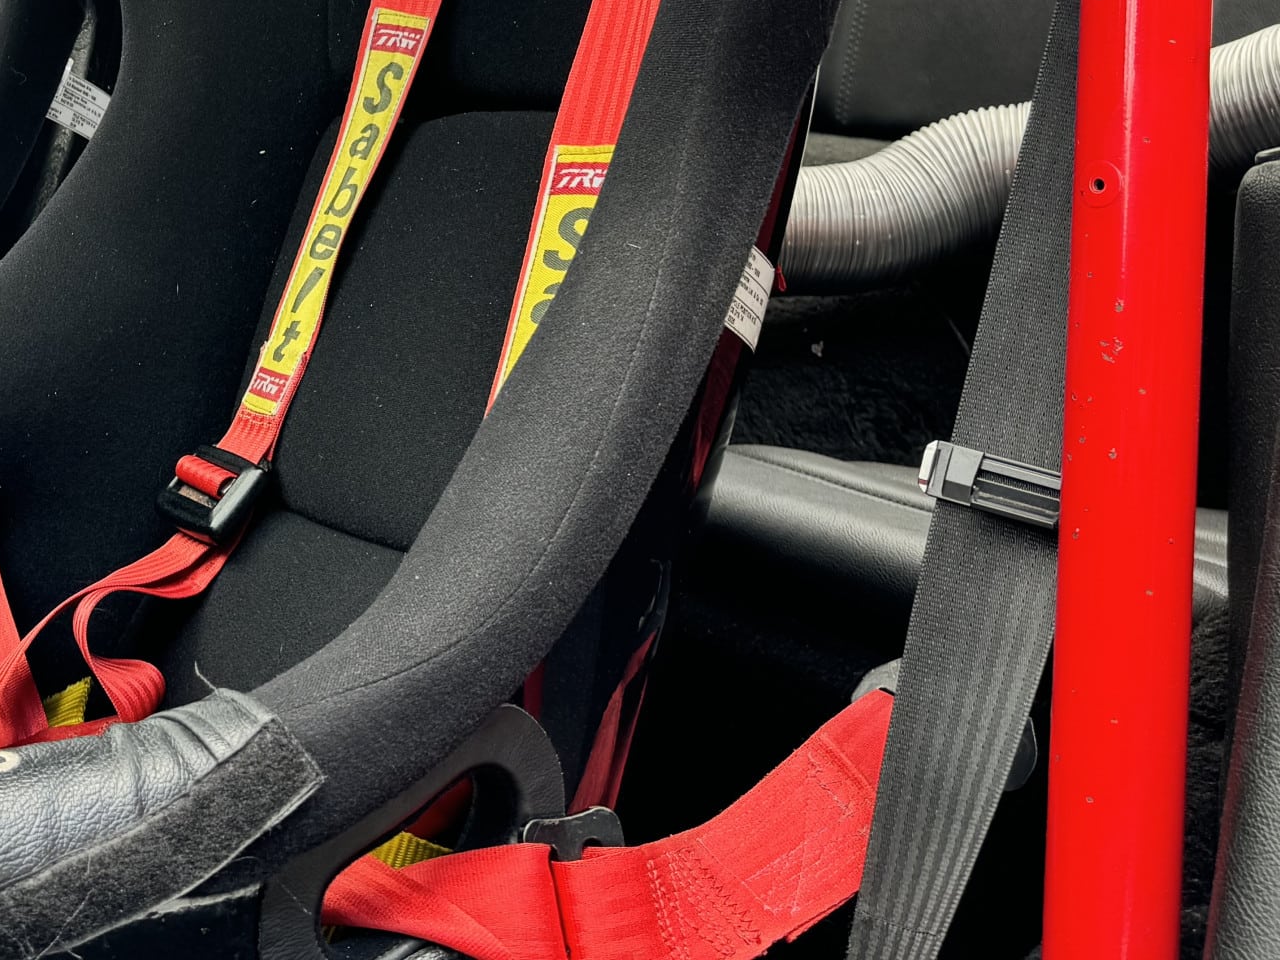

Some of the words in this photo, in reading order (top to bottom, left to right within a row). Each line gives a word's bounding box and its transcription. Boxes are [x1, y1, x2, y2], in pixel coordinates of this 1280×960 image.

[375, 29, 421, 50] TRW
[272, 61, 404, 363] Sabelt
[252, 372, 286, 395] TRW
